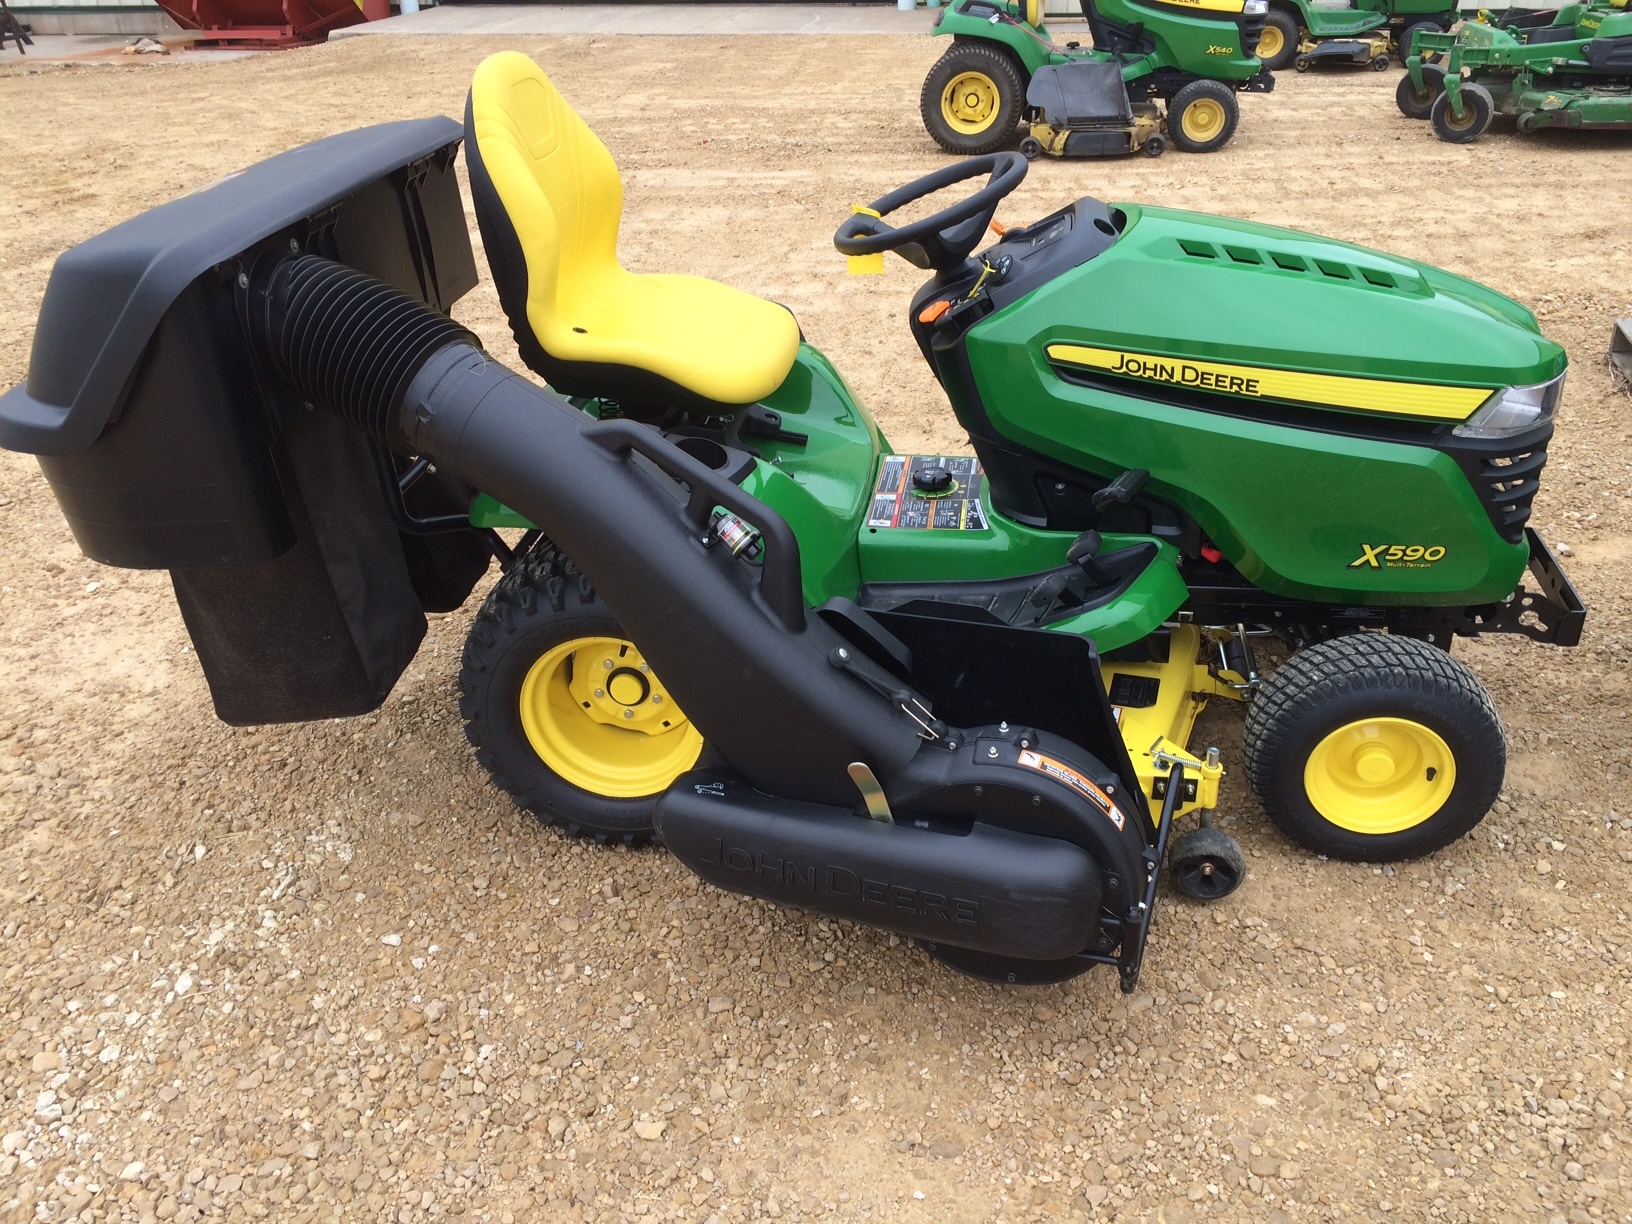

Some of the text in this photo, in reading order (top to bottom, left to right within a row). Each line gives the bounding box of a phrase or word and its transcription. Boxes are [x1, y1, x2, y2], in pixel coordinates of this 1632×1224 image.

[1206, 45, 1233, 54] X540
[1111, 353, 1260, 394] JOHN DEERE
[1348, 543, 1447, 568] X590
[699, 837, 979, 926] JOHN DEERE
